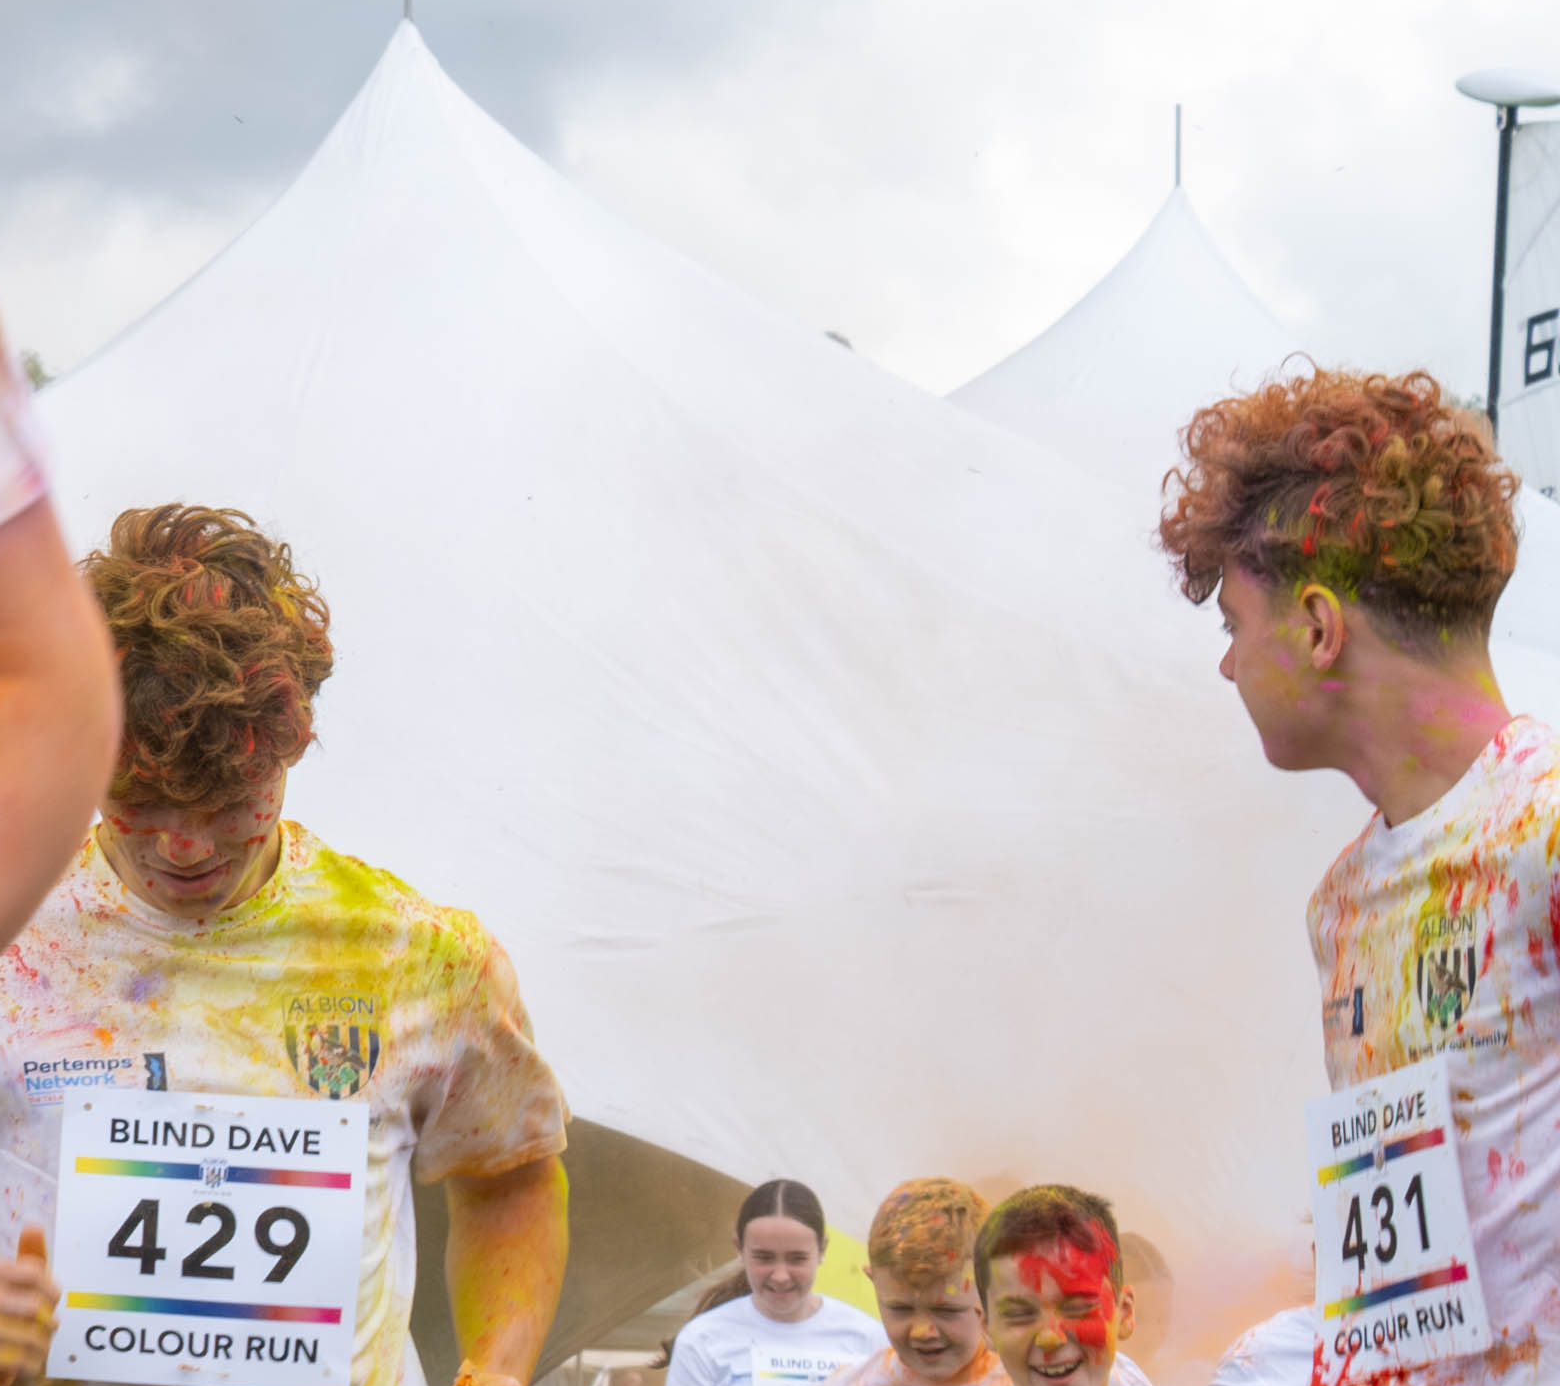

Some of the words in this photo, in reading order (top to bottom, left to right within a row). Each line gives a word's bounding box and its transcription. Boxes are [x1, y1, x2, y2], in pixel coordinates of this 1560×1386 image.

[1524, 308, 1560, 387] 6
[1421, 915, 1472, 938] ALBION
[288, 995, 374, 1015] ALBION
[1470, 1029, 1509, 1048] family
[23, 1057, 132, 1074] Pertemps
[25, 1072, 116, 1091] Network
[109, 1118, 215, 1149] BLIND
[228, 1124, 321, 1156] DAVE
[1331, 1110, 1378, 1147] BLIND
[1383, 1090, 1426, 1131] DAVE
[106, 1197, 312, 1284] 429
[1341, 1172, 1431, 1273] 431
[84, 1324, 234, 1361] COLOUR
[245, 1334, 320, 1365] RUN
[1334, 1311, 1411, 1356] COLOUR
[1416, 1295, 1466, 1337] RUN
[771, 1357, 813, 1370] BLIND
